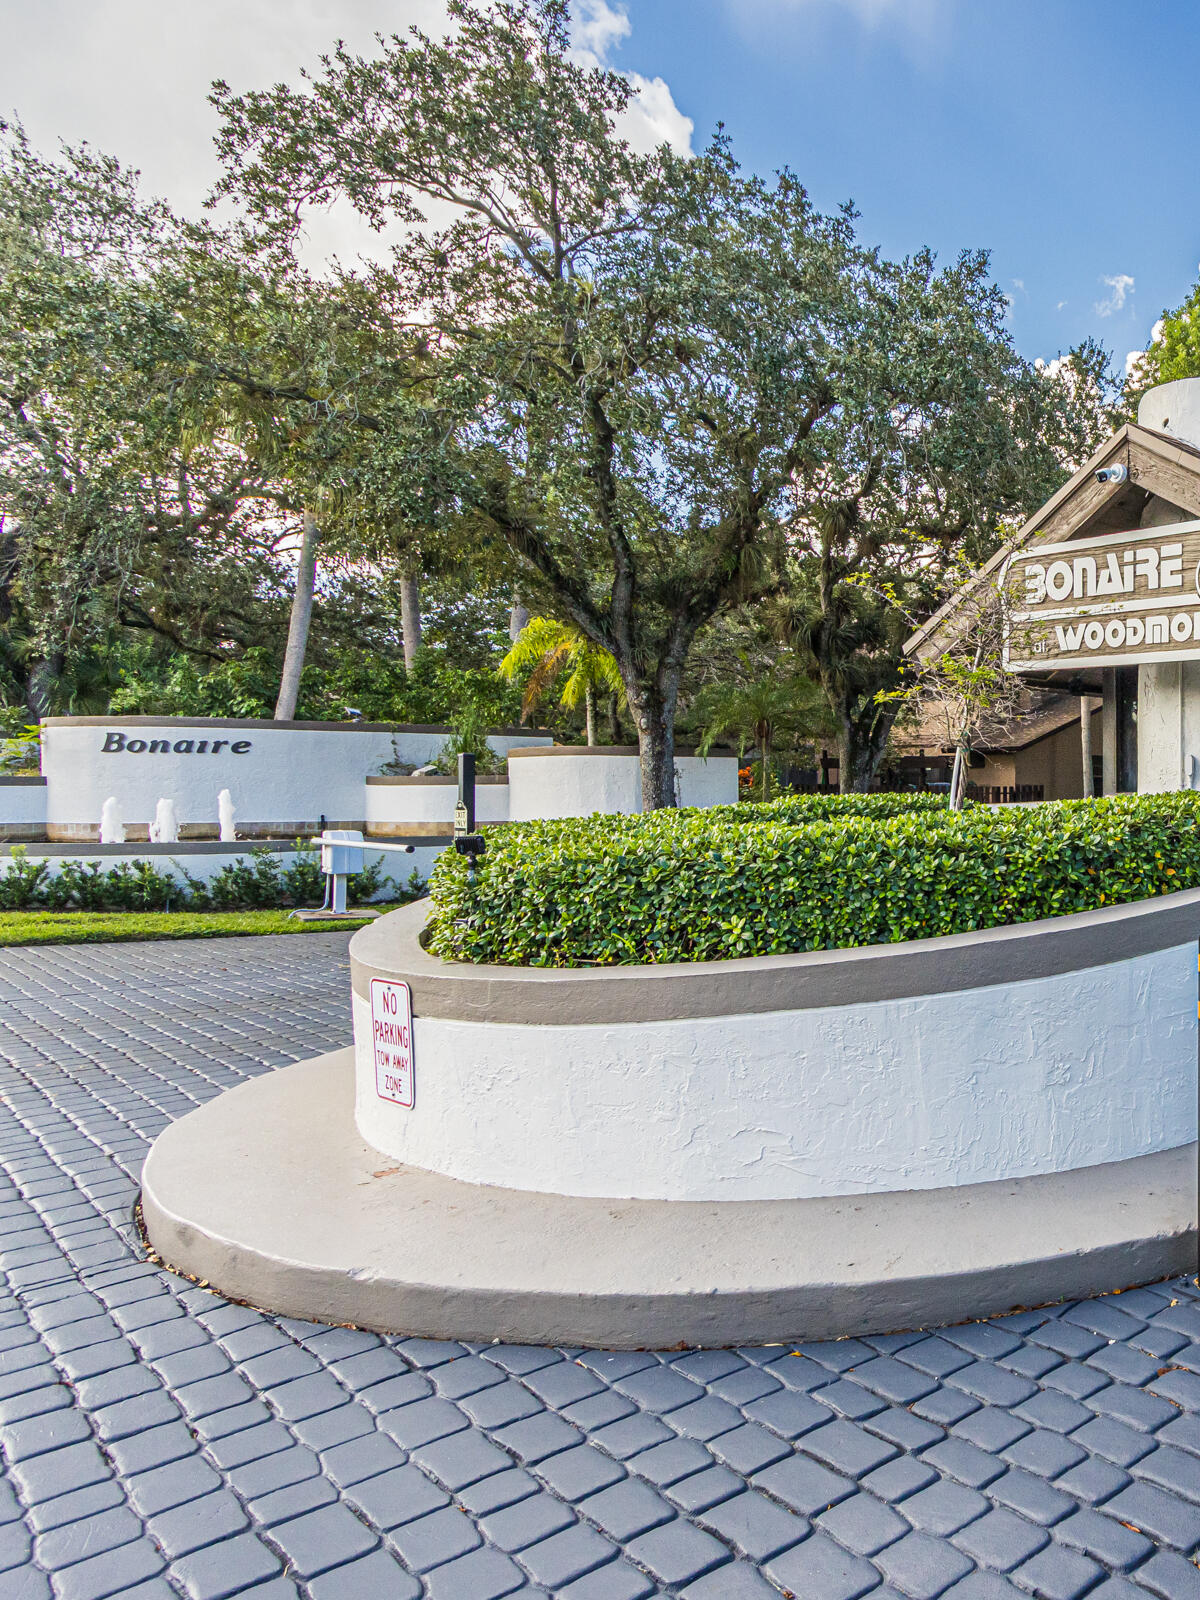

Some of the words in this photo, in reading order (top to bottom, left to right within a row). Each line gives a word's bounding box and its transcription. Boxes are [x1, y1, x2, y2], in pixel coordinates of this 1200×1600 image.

[101, 732, 252, 754] Bonaire
[383, 992, 397, 1015] NO
[375, 1020, 408, 1048] PARKING
[377, 1050, 390, 1068] TOW
[393, 1054, 408, 1072] AWAY
[385, 1074, 402, 1094] ZONE
